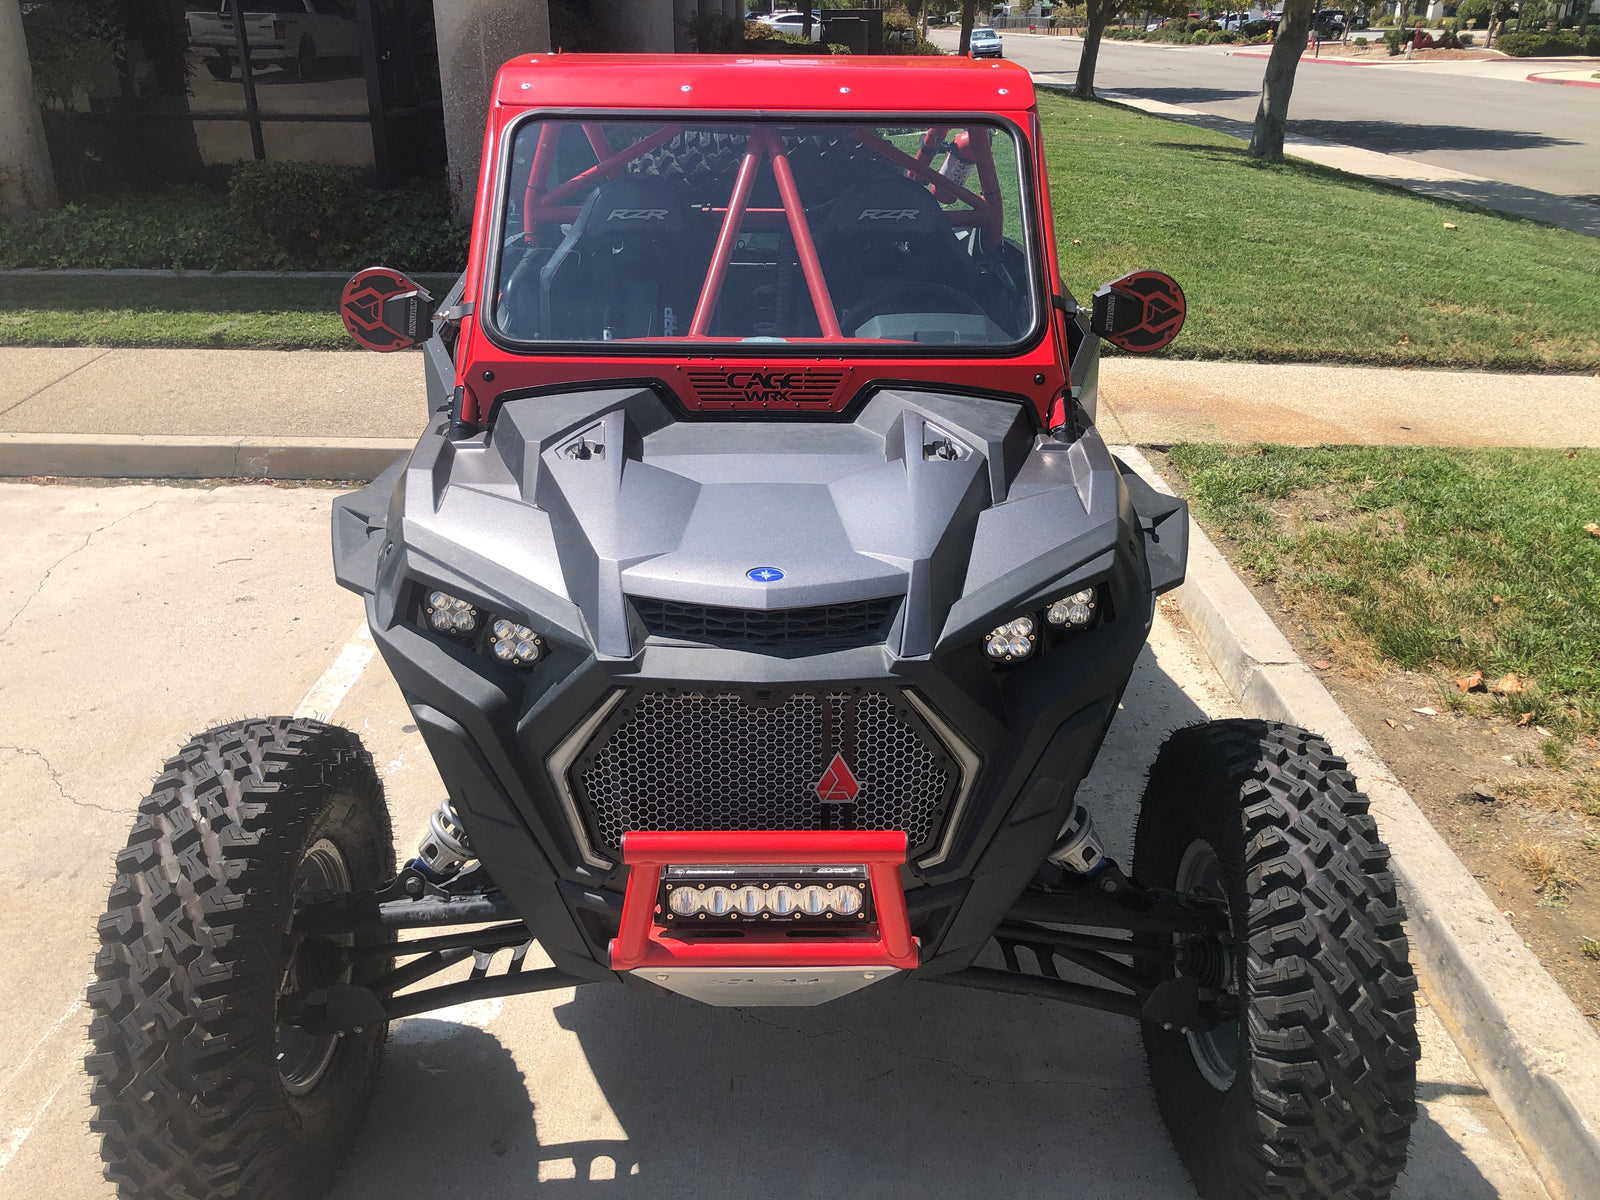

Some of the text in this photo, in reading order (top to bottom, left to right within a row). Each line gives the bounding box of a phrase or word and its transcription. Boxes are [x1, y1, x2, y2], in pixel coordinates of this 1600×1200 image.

[607, 209, 669, 221] RZR
[858, 209, 920, 220] RZR
[727, 373, 803, 389] CAGE
[743, 391, 791, 401] WRX
